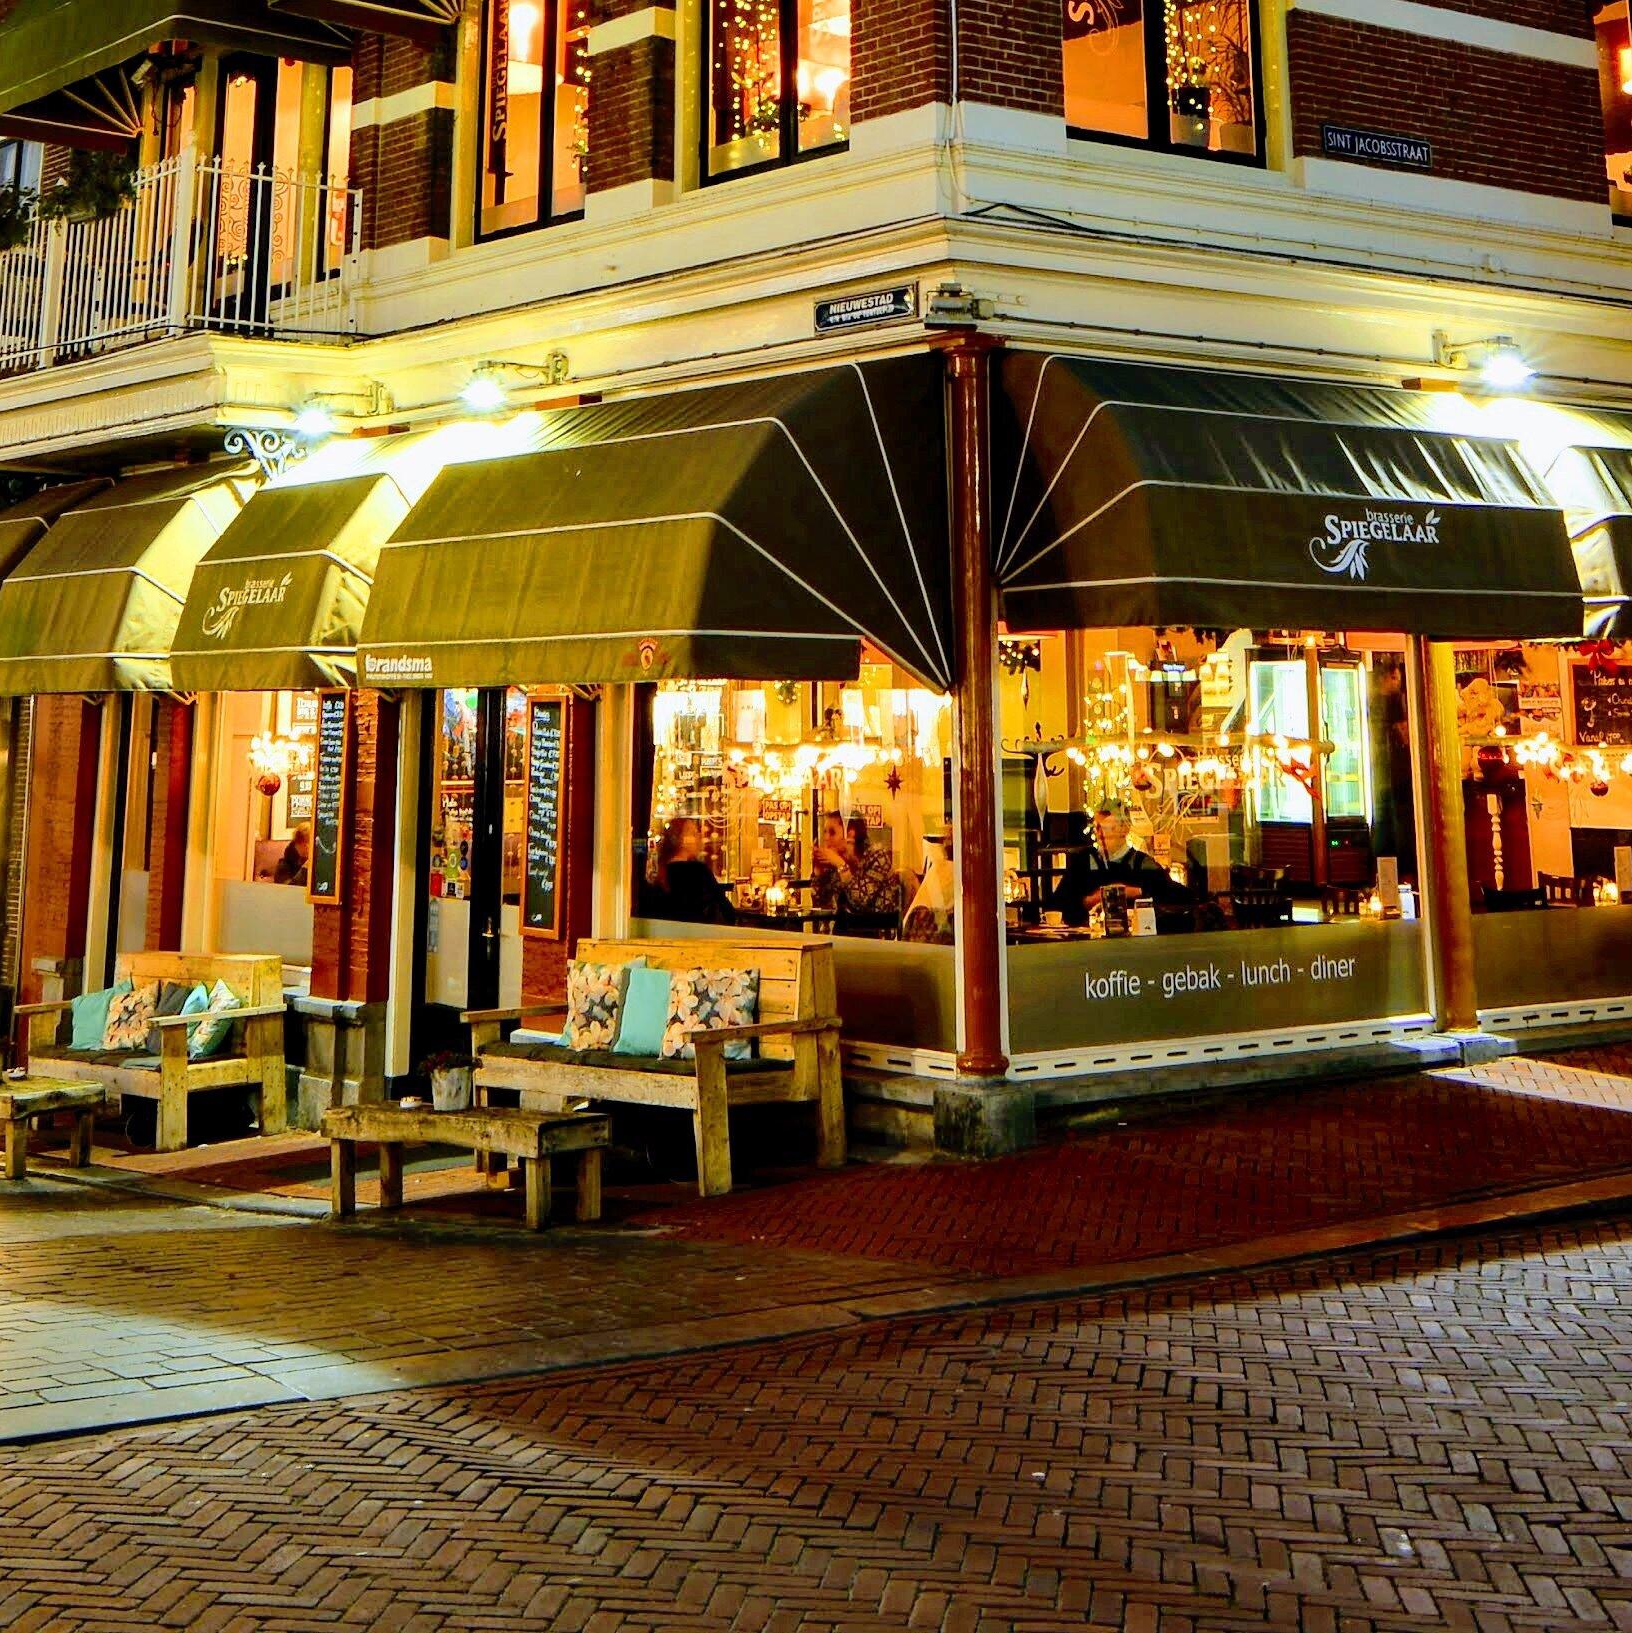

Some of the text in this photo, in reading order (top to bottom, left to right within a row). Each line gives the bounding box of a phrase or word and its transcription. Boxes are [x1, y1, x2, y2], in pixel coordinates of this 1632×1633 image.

[1328, 132, 1428, 161] SINT JACOBSSTRAAT
[829, 293, 894, 315] NIEUWESTAD
[1366, 508, 1414, 525] brasserie
[365, 653, 433, 673] brandsma
[1085, 970, 1141, 999] koffie
[1162, 962, 1221, 999] gebak
[1241, 958, 1290, 986] lunch
[1310, 955, 1356, 980] diner
